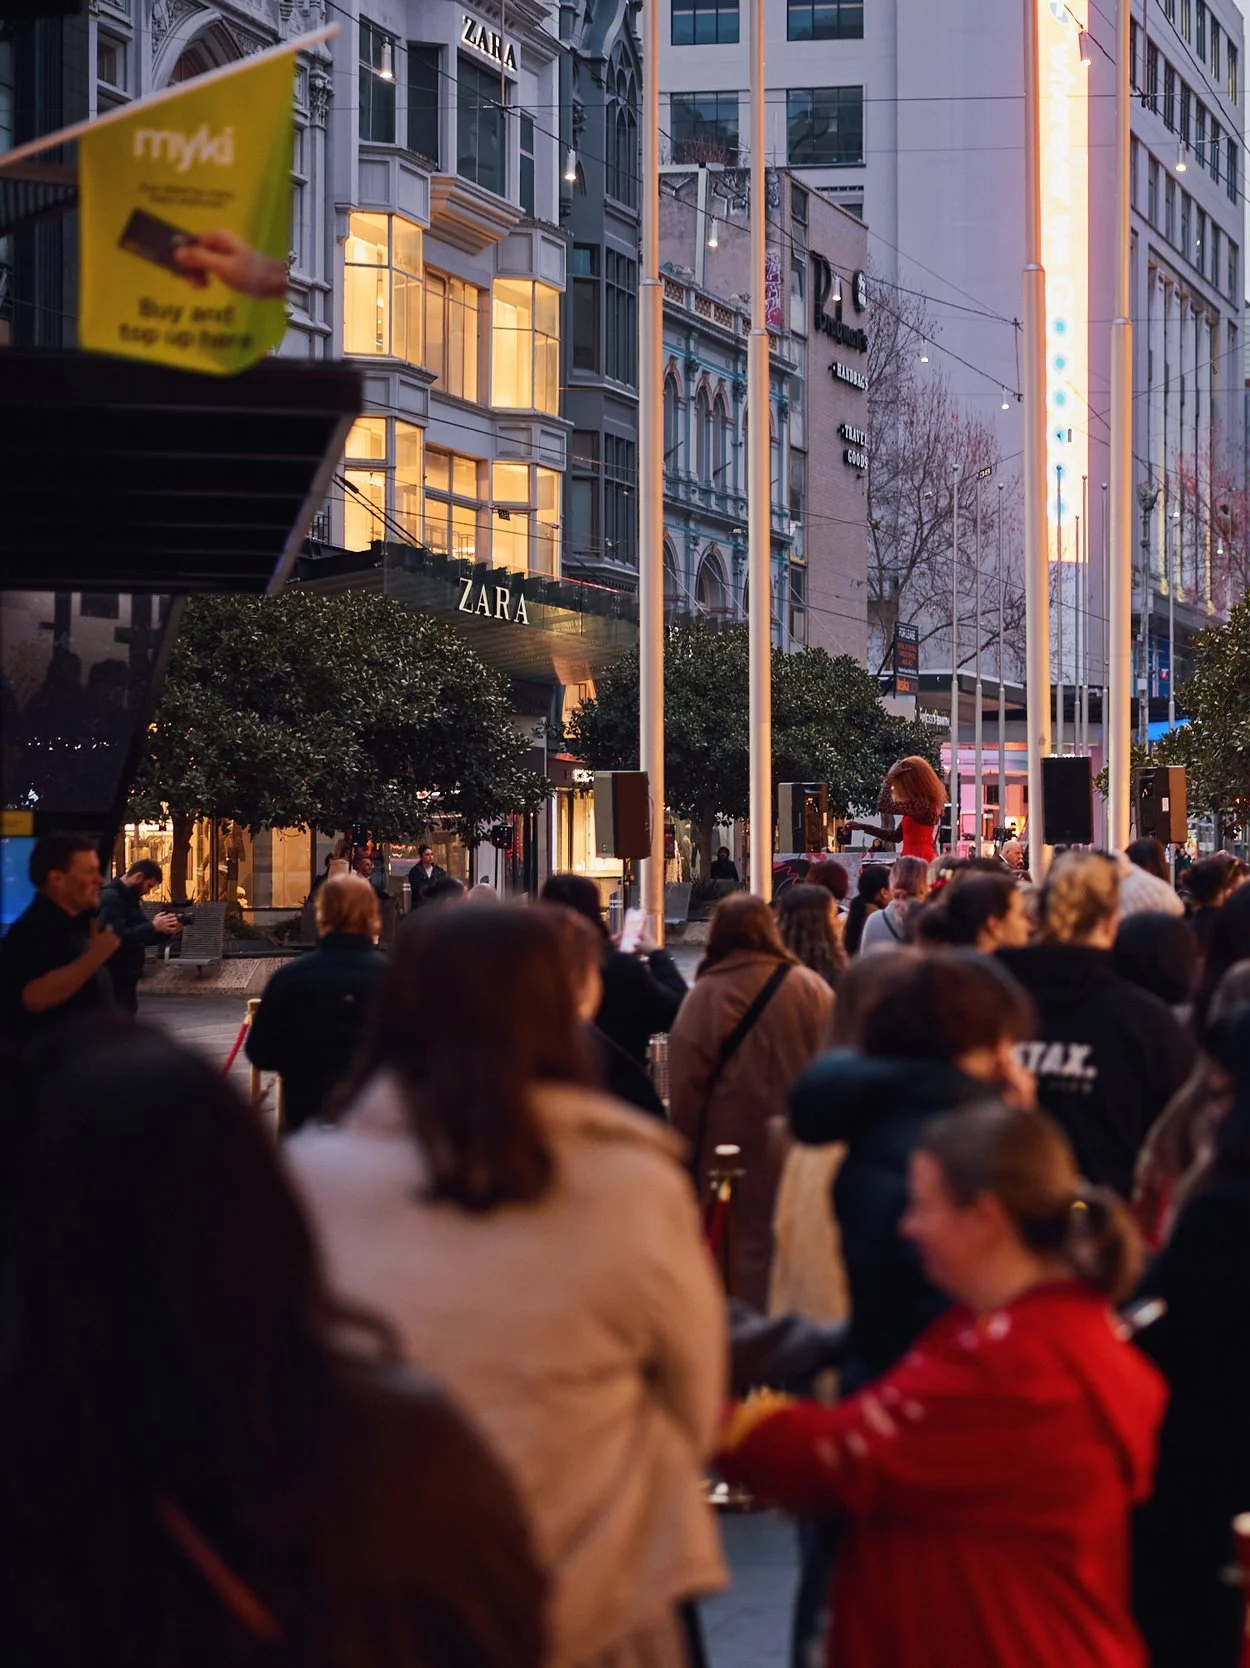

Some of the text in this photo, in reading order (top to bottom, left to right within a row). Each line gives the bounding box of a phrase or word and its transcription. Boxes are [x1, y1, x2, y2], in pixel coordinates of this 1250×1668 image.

[462, 15, 518, 73] ZARA
[133, 123, 236, 172] myki
[138, 297, 236, 324] Buy and
[119, 324, 255, 350] top up here
[837, 362, 869, 391] HANDBAGS
[844, 424, 868, 448] TRAVEL
[847, 449, 869, 470] GOODS
[459, 577, 530, 625] ZARA
